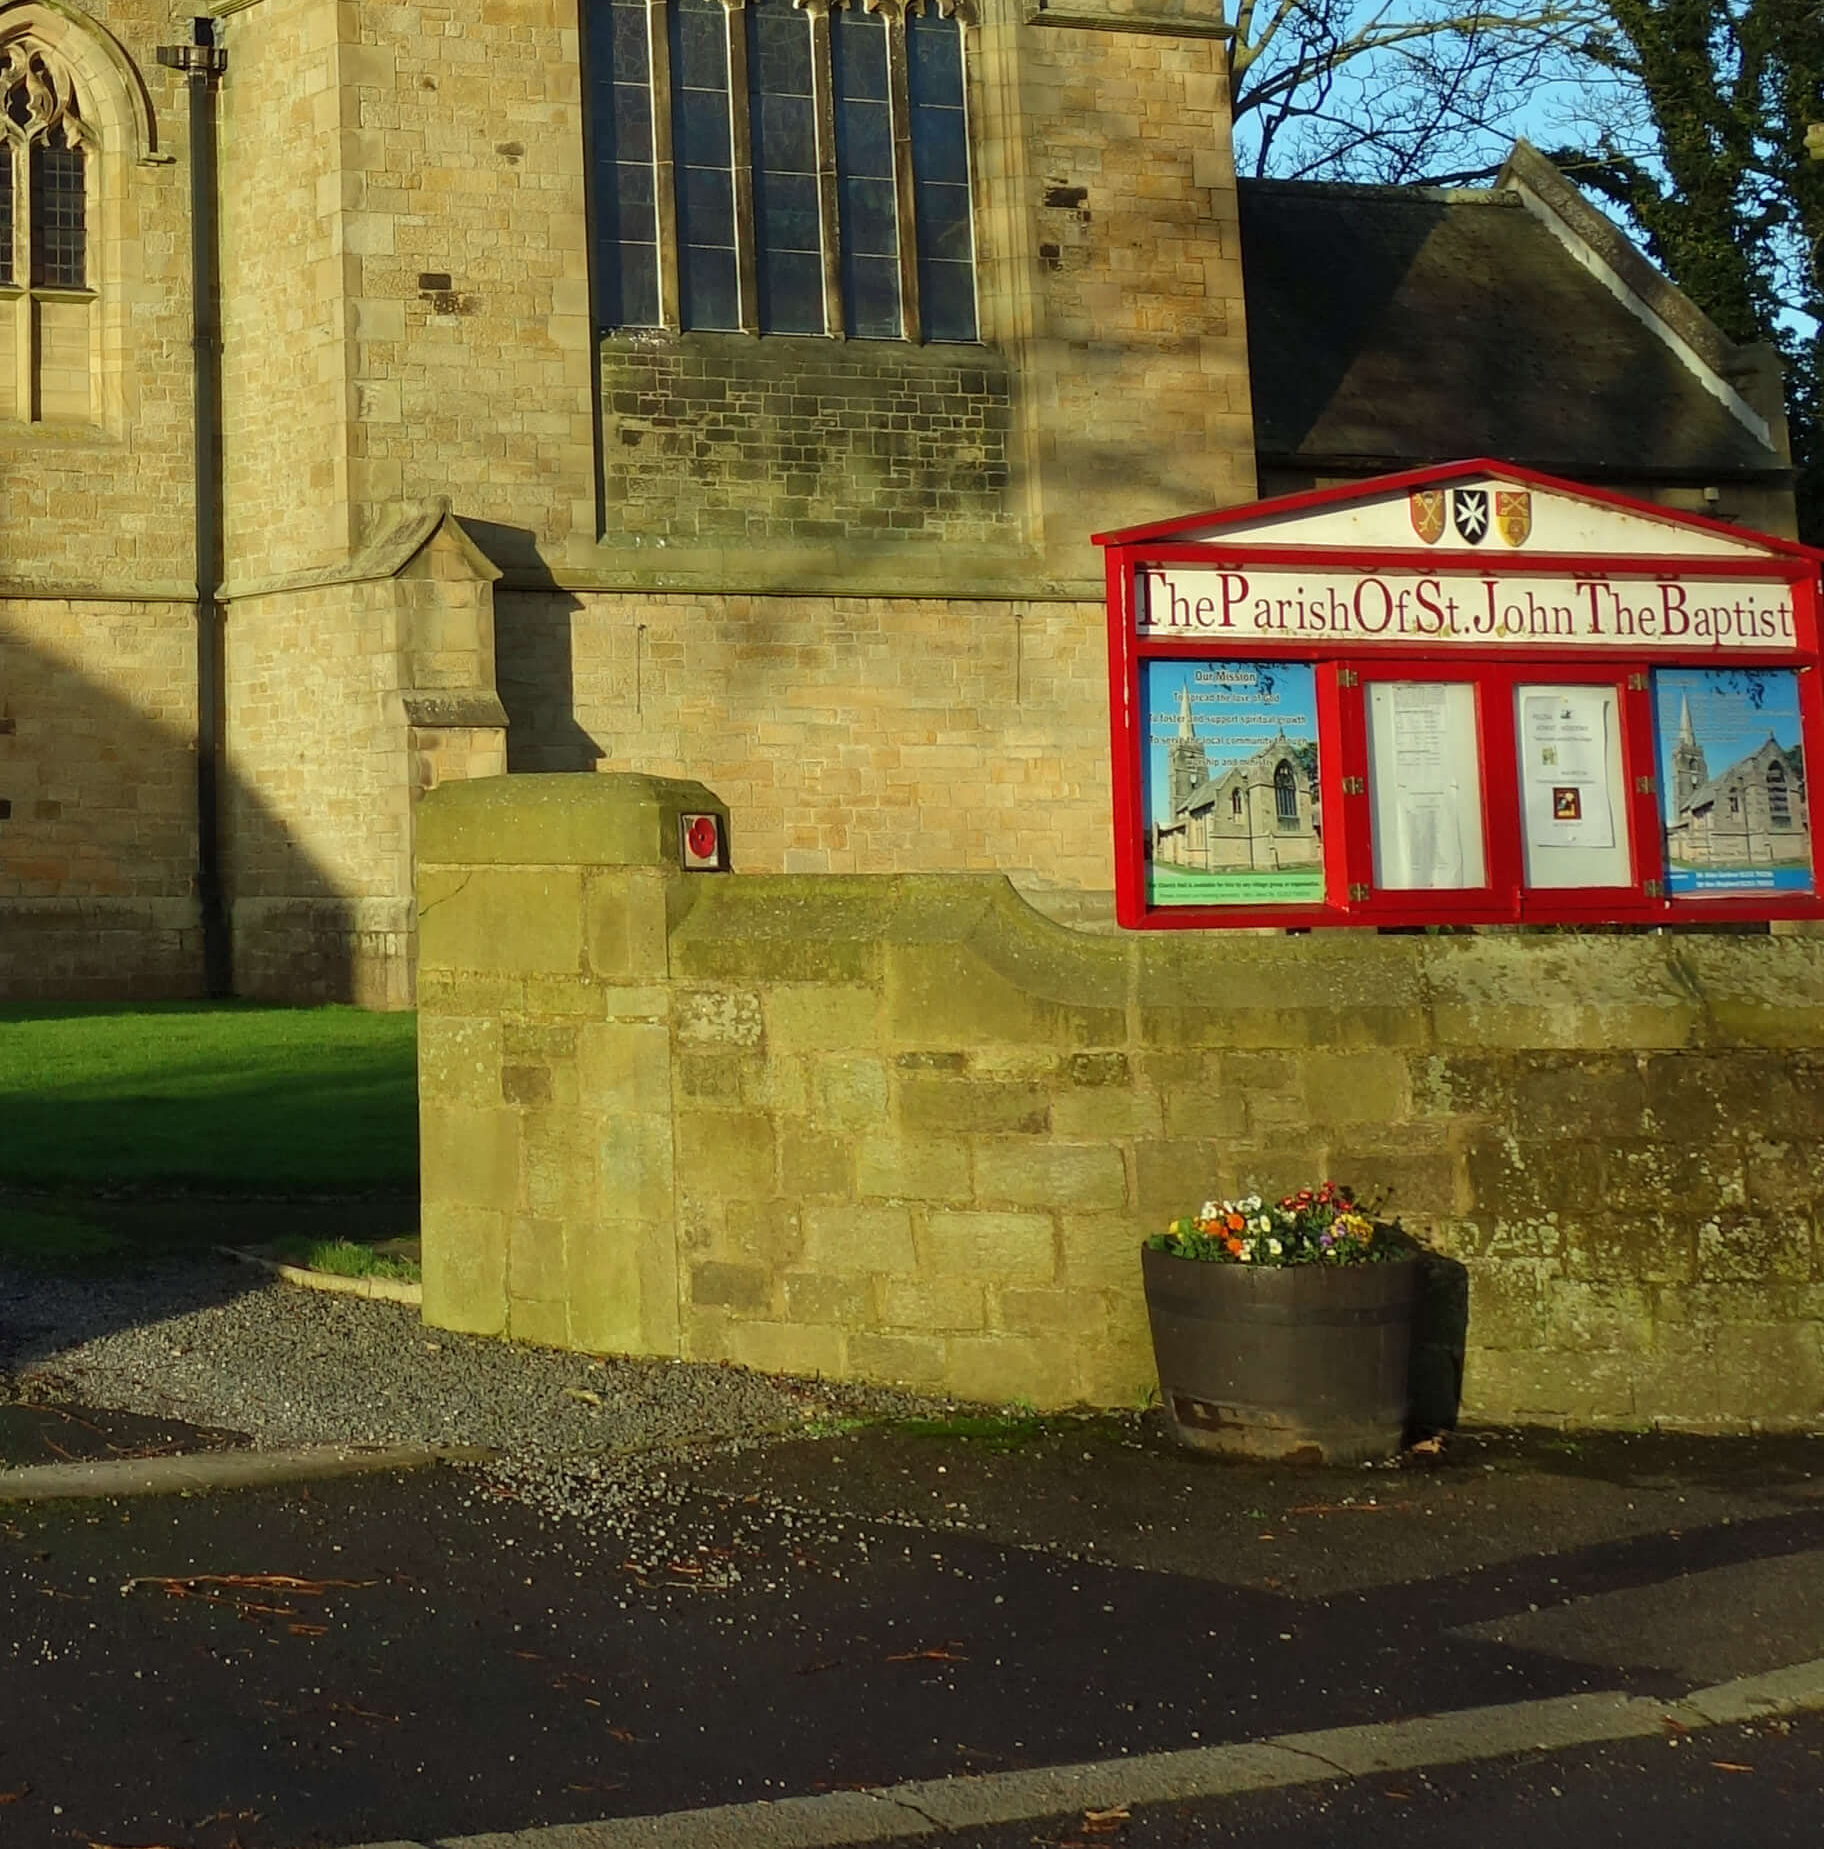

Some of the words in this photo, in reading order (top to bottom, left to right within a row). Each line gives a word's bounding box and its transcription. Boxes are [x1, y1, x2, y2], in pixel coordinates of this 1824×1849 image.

[1136, 571, 1216, 627] The
[1216, 573, 1352, 632] Parish
[1353, 577, 1411, 633] Of
[1415, 579, 1470, 634] St.
[1473, 580, 1574, 635] John
[1575, 582, 1656, 637] The
[1657, 584, 1793, 651] Baptist
[1195, 670, 1213, 682] Our
[1215, 670, 1257, 682] Mission
